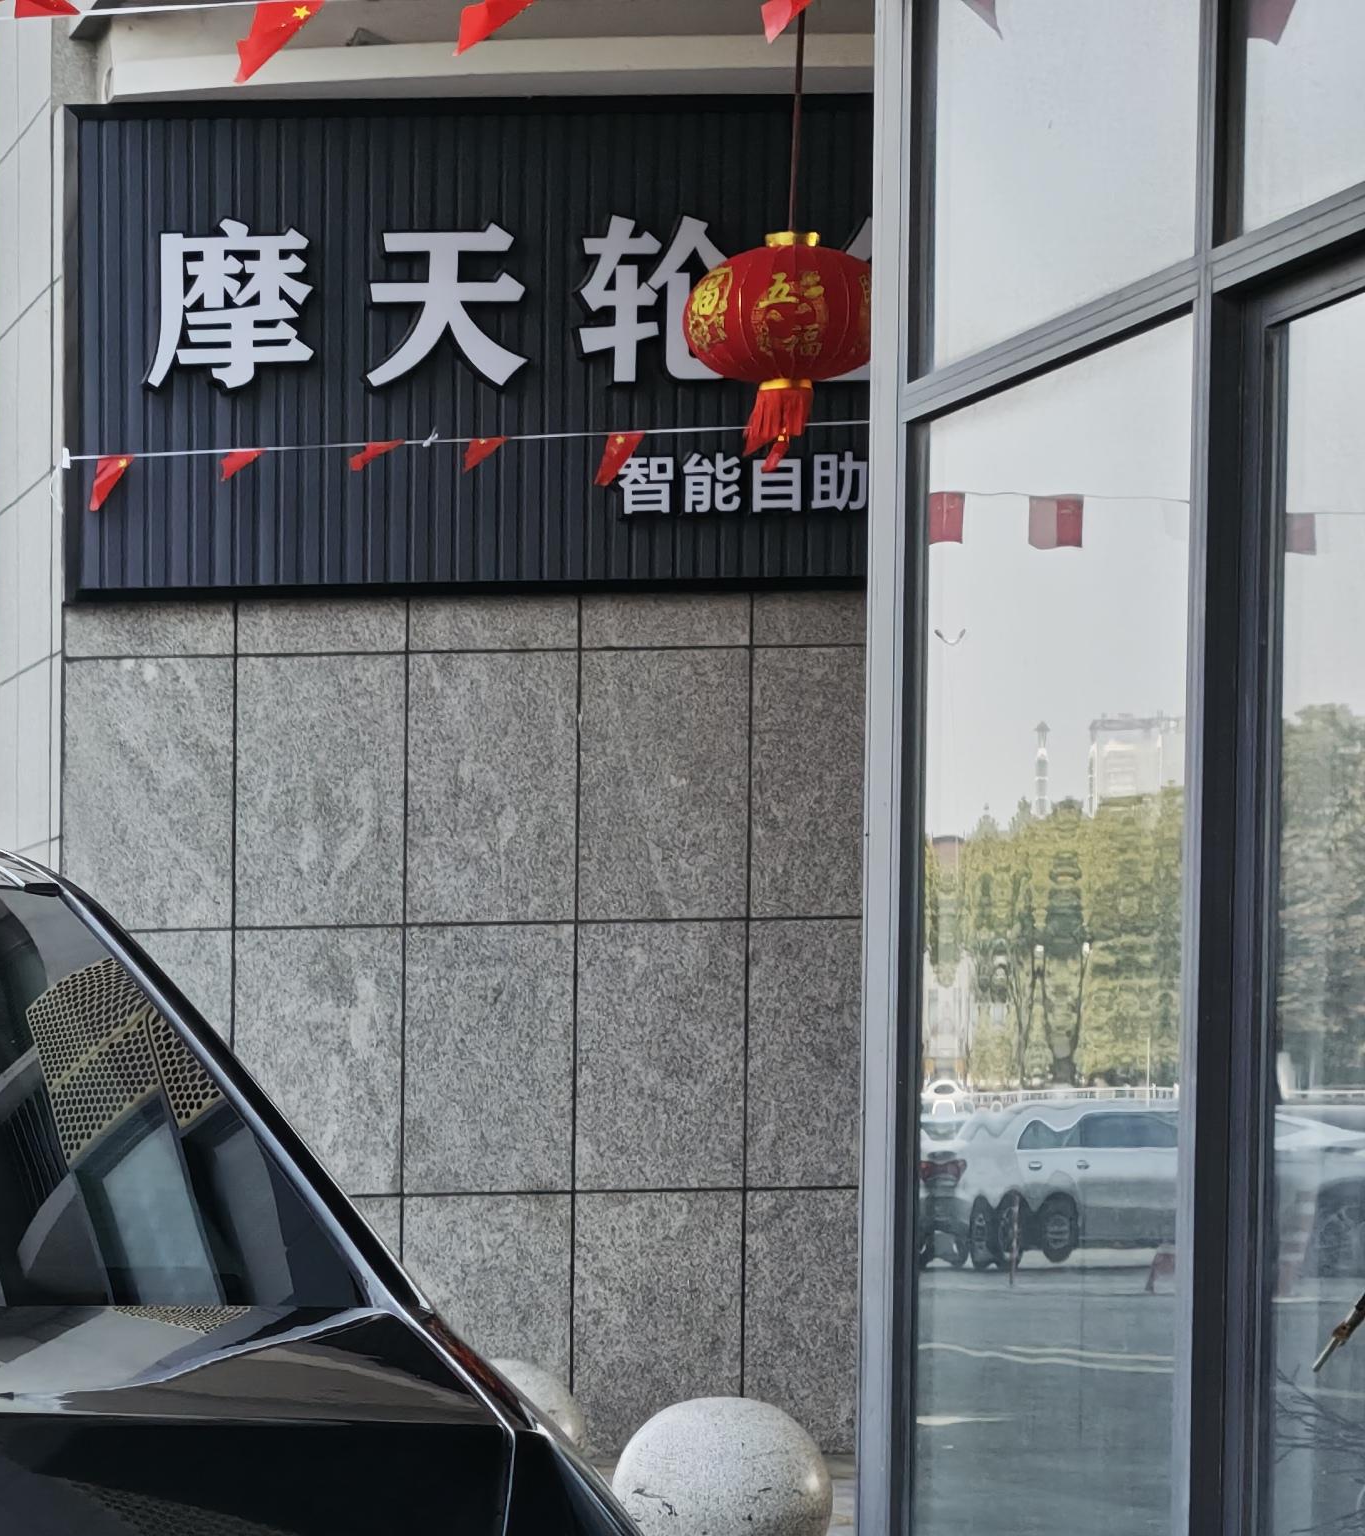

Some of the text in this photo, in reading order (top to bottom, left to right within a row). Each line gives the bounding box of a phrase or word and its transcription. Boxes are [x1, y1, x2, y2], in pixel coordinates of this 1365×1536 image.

[147, 214, 871, 389] 摩天轮
[618, 450, 868, 515] 智能自助
